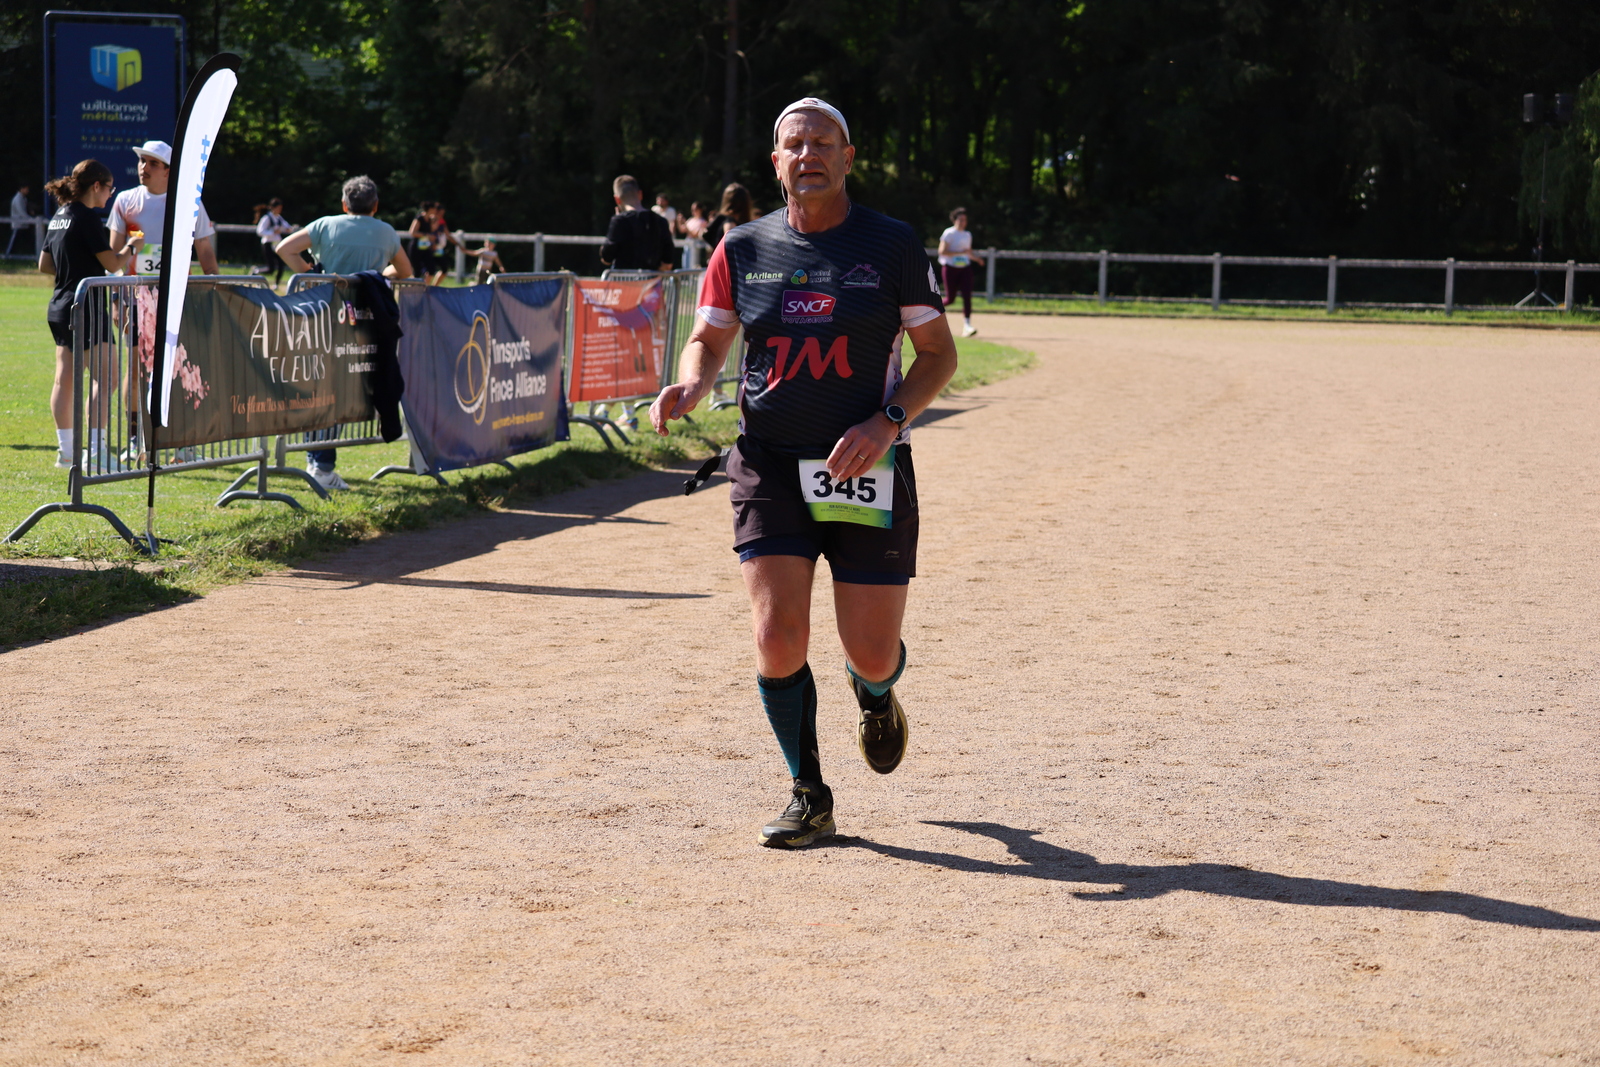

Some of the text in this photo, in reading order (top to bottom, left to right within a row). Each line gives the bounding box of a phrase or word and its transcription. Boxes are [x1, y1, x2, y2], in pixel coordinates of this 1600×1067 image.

[785, 300, 832, 312] SNCF
[250, 300, 332, 358] ANATO
[270, 354, 325, 383] FLEURS
[492, 336, 531, 369] Tnsports
[490, 371, 547, 403] Fnce Alliance
[813, 471, 876, 503] 345
